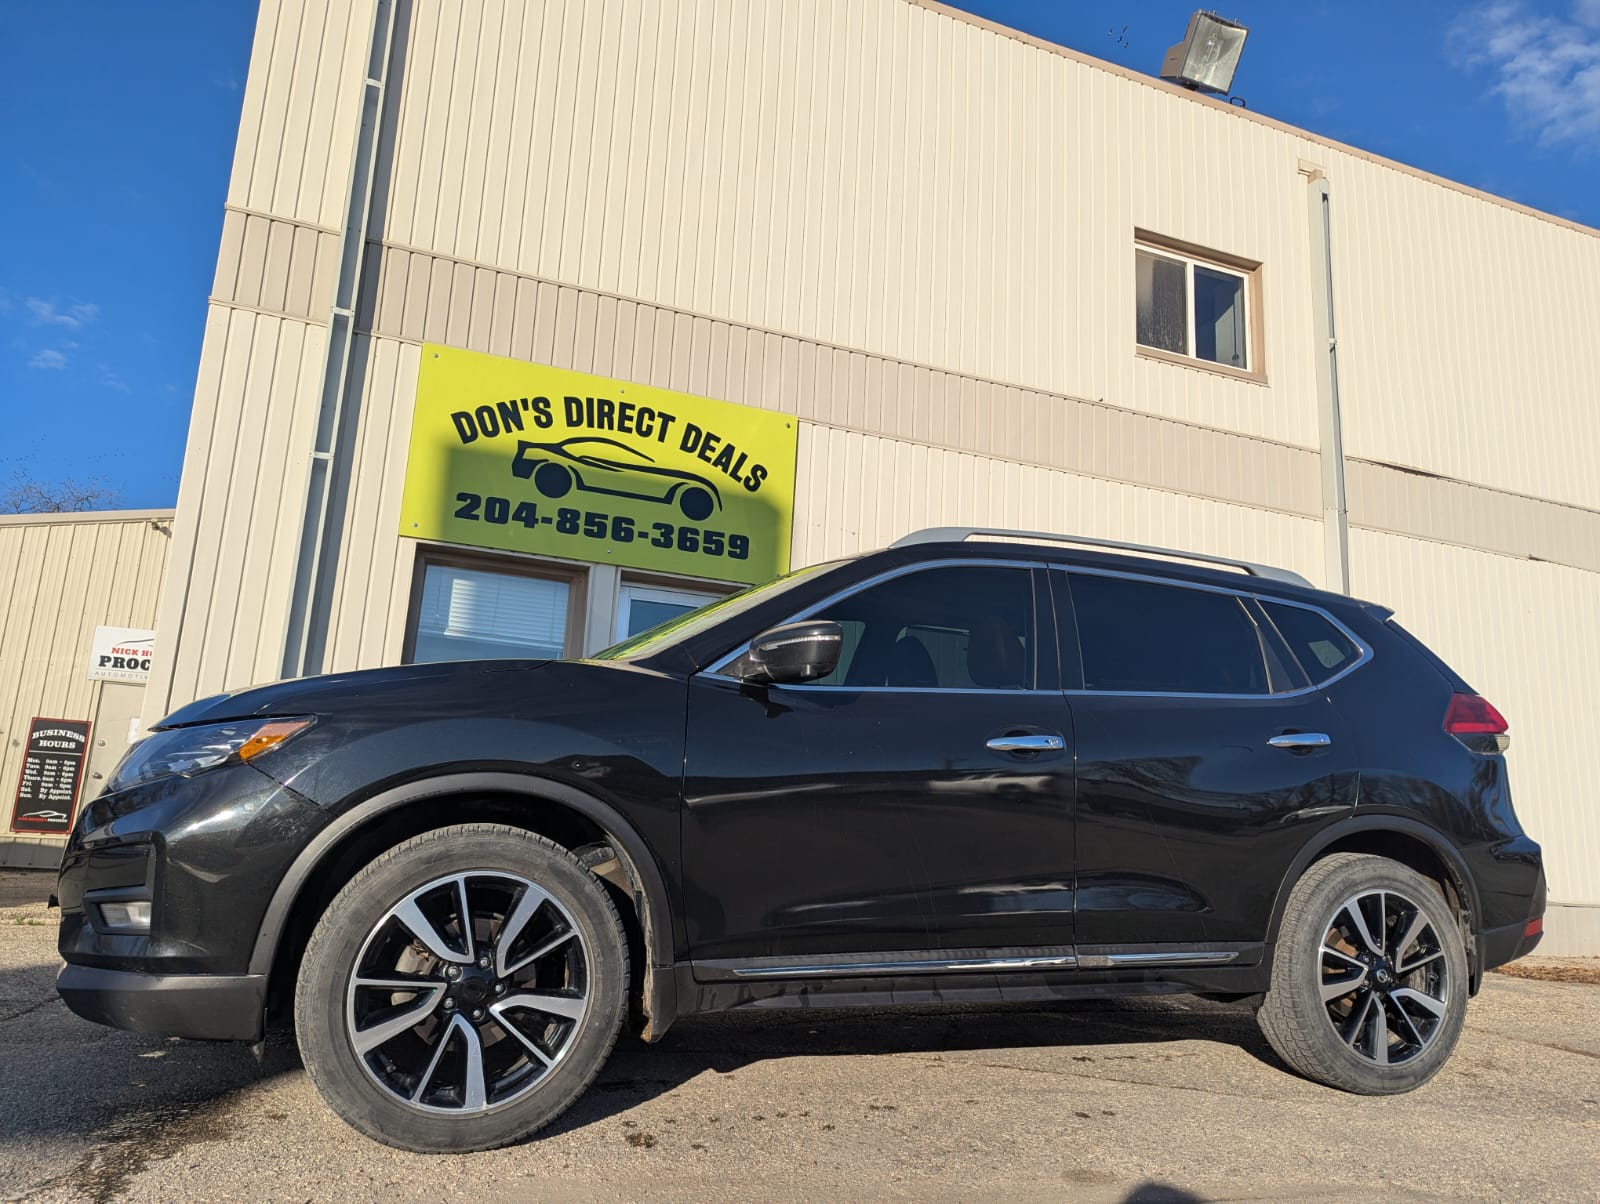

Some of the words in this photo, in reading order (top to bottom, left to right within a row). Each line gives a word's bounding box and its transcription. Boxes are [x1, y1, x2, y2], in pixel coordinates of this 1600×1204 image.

[450, 396, 553, 444] DON'S
[564, 396, 676, 443] DIRECT
[680, 423, 768, 492] DEALS
[454, 492, 749, 560] 204-856-3659
[111, 647, 139, 656] NICK
[32, 729, 85, 743] BUSINESS
[39, 740, 76, 749] HOURS
